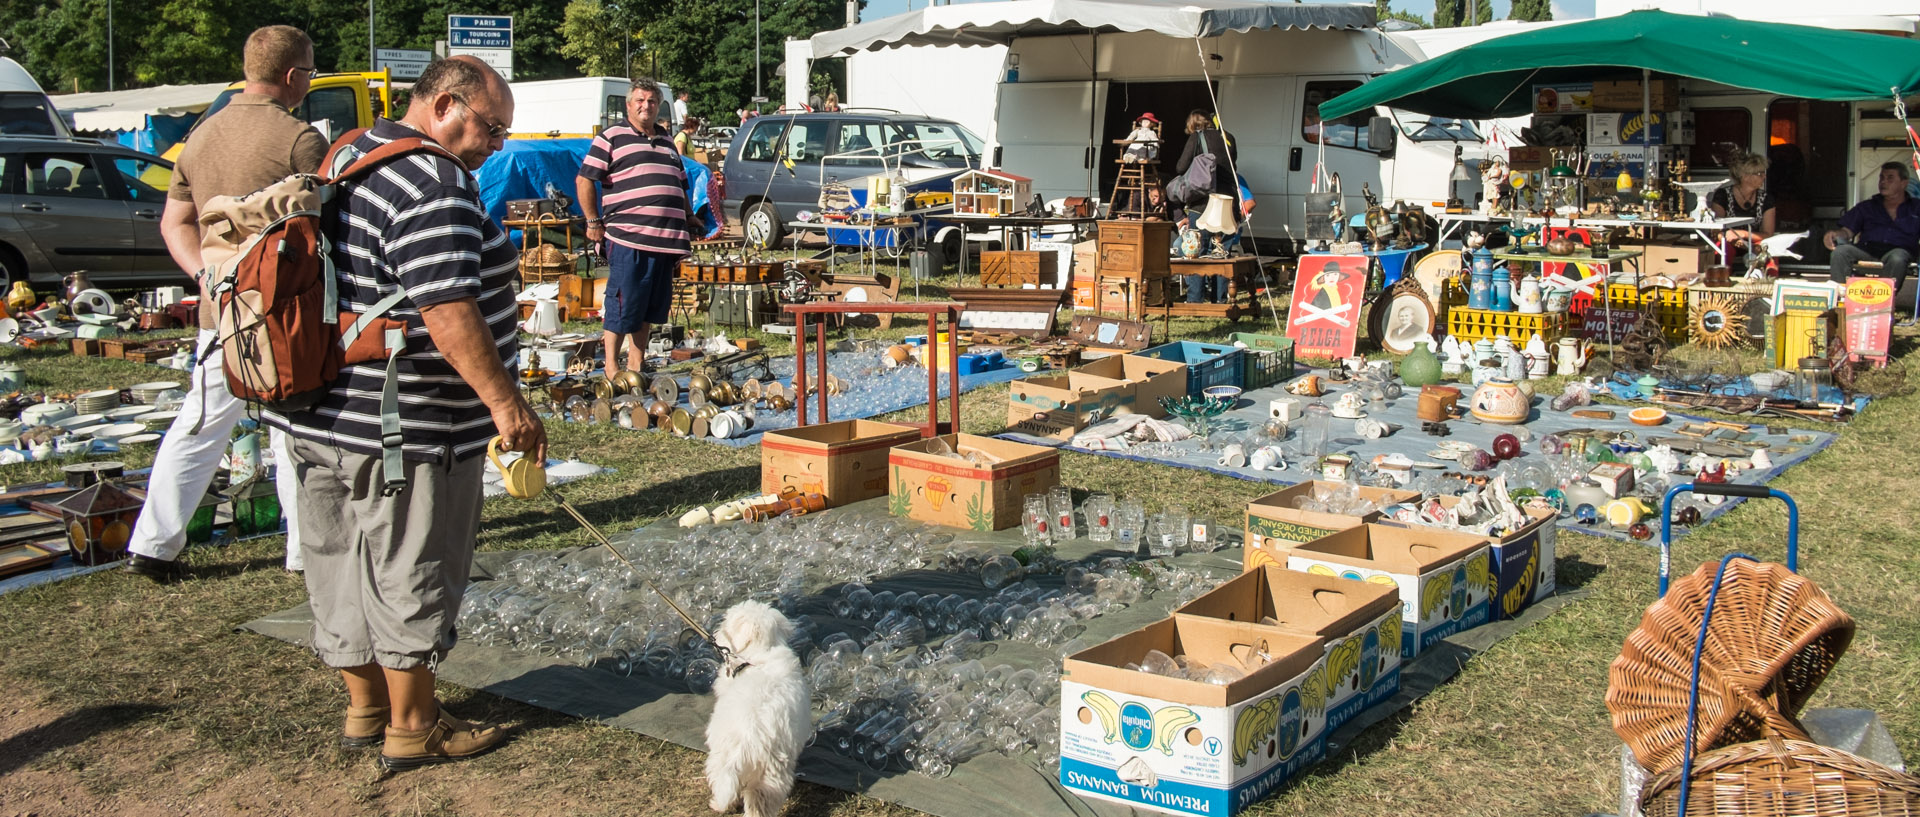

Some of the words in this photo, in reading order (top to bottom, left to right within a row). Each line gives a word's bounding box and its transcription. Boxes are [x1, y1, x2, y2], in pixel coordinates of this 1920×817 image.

[1848, 288, 1891, 296] PENNZOIL
[1785, 300, 1827, 308] MAZDA
[1299, 327, 1341, 348] BELGA
[1018, 419, 1062, 436] BANANAS
[1257, 517, 1297, 533] ORGANIC
[1122, 714, 1152, 730] Chiquita
[1329, 697, 1364, 731] BANANAS
[1067, 770, 1130, 797] BANANAS
[1238, 767, 1282, 808] BANANAS
[1140, 787, 1211, 813] PREMIUM
